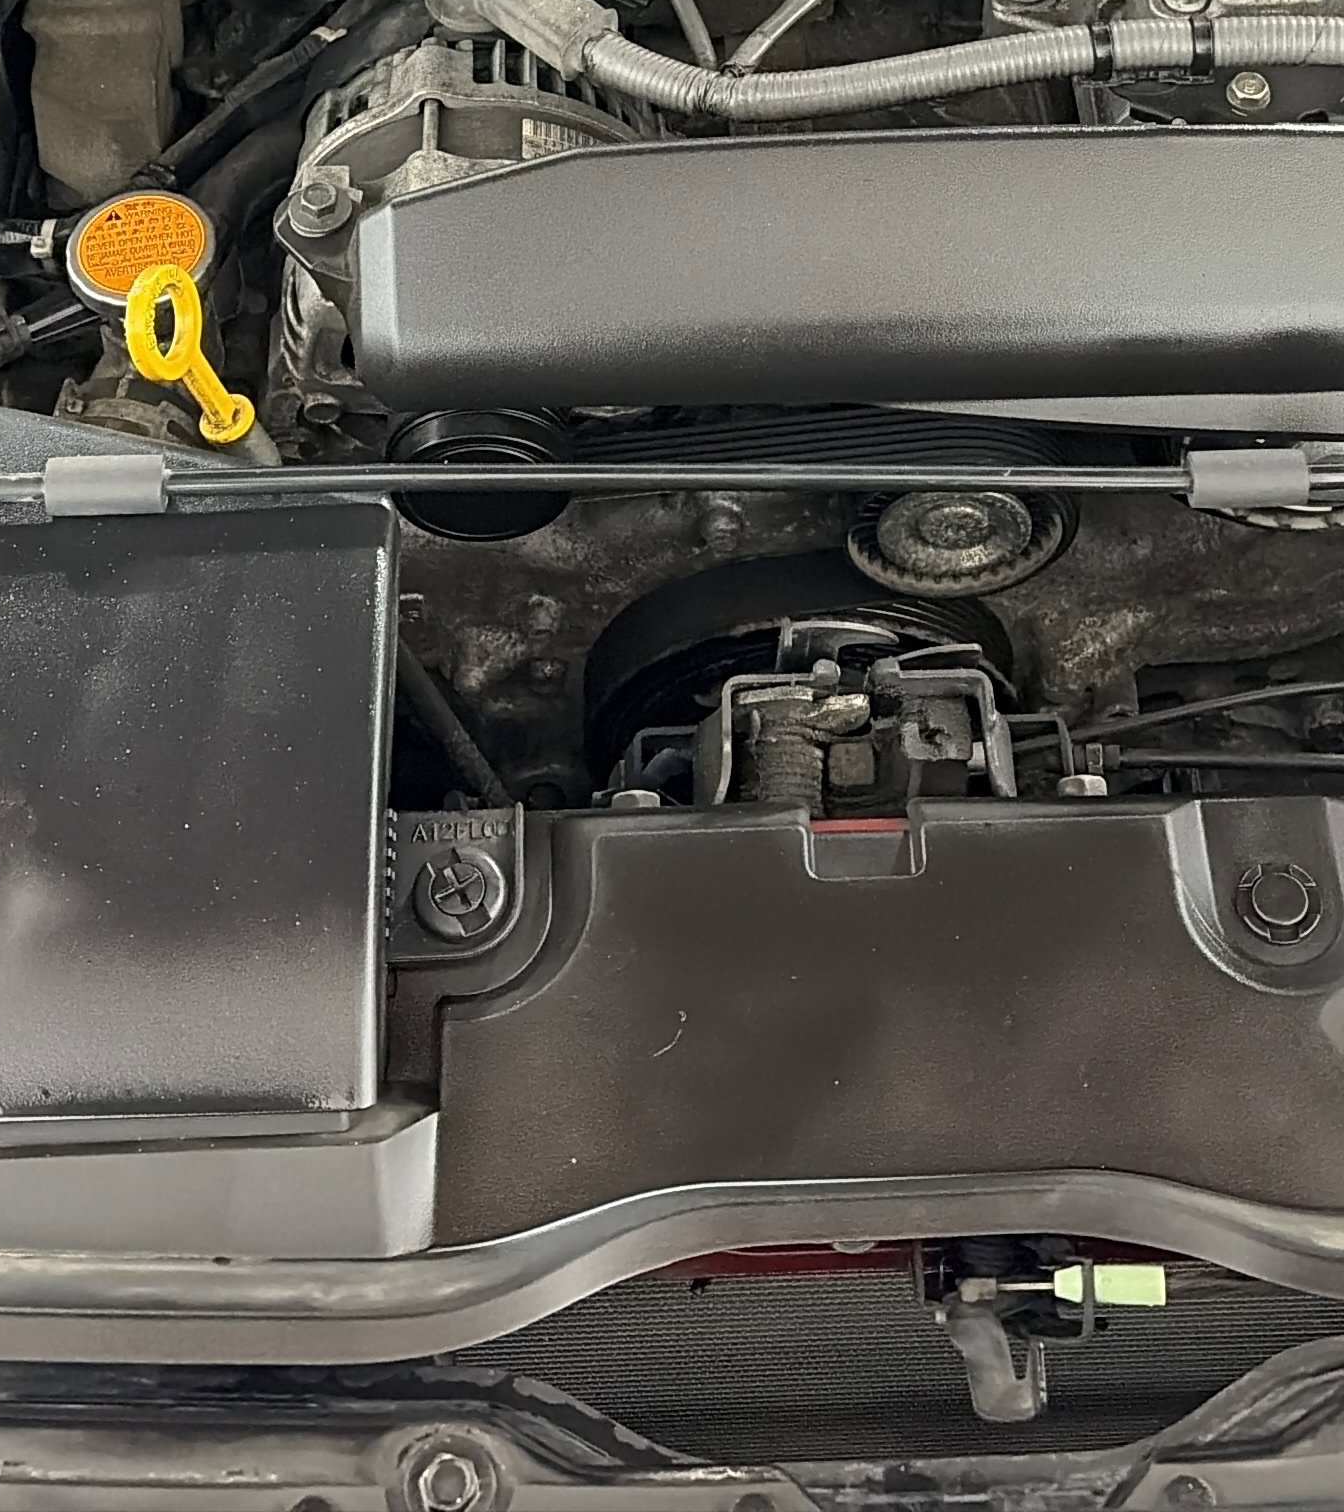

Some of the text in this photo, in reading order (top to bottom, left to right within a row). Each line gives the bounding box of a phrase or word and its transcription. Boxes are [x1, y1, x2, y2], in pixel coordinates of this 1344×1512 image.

[124, 206, 173, 220] WARNING
[86, 229, 195, 253] NEVER OPEN WHEN HOT
